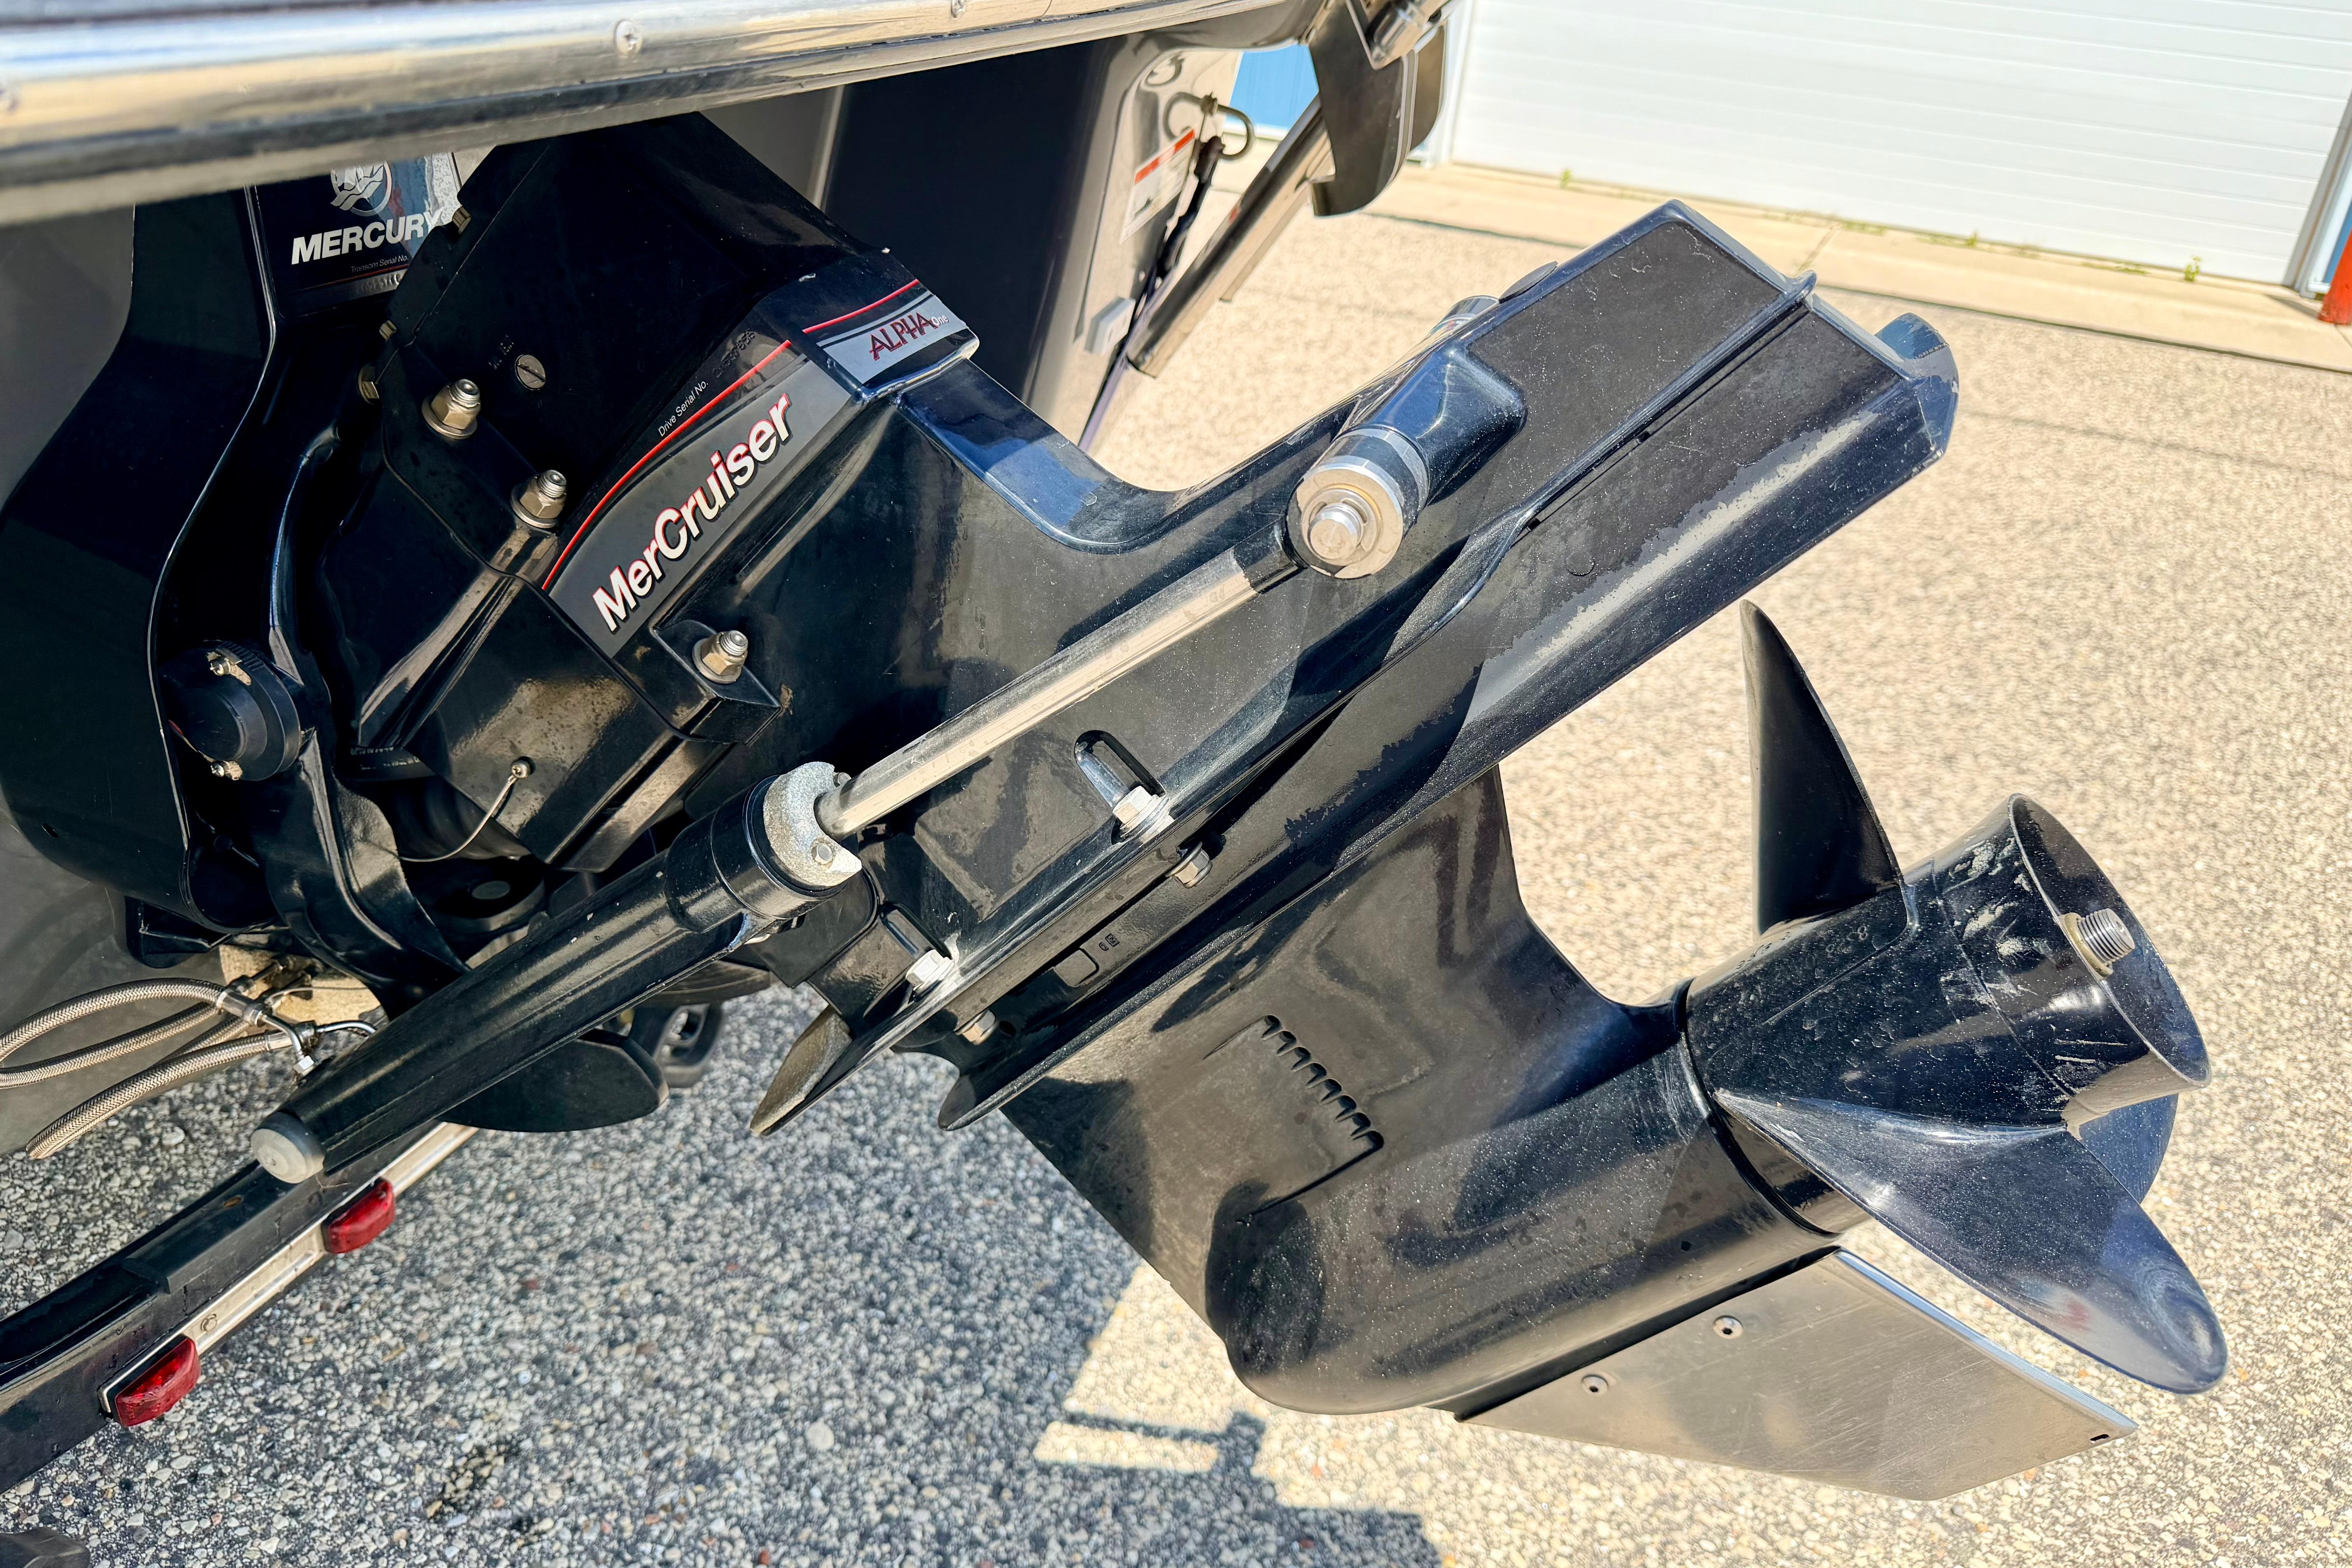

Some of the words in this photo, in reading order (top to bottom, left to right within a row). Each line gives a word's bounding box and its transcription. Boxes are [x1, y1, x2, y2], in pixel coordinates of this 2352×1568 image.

[291, 209, 442, 265] MERCURY
[351, 262, 378, 273] Transom
[379, 257, 397, 267] Serial
[868, 312, 938, 361] ALPHA
[931, 315, 949, 326] One
[658, 415, 677, 437] Drive
[675, 391, 696, 417] Serial
[695, 380, 709, 396] No.
[592, 392, 792, 634] MerCruiser
